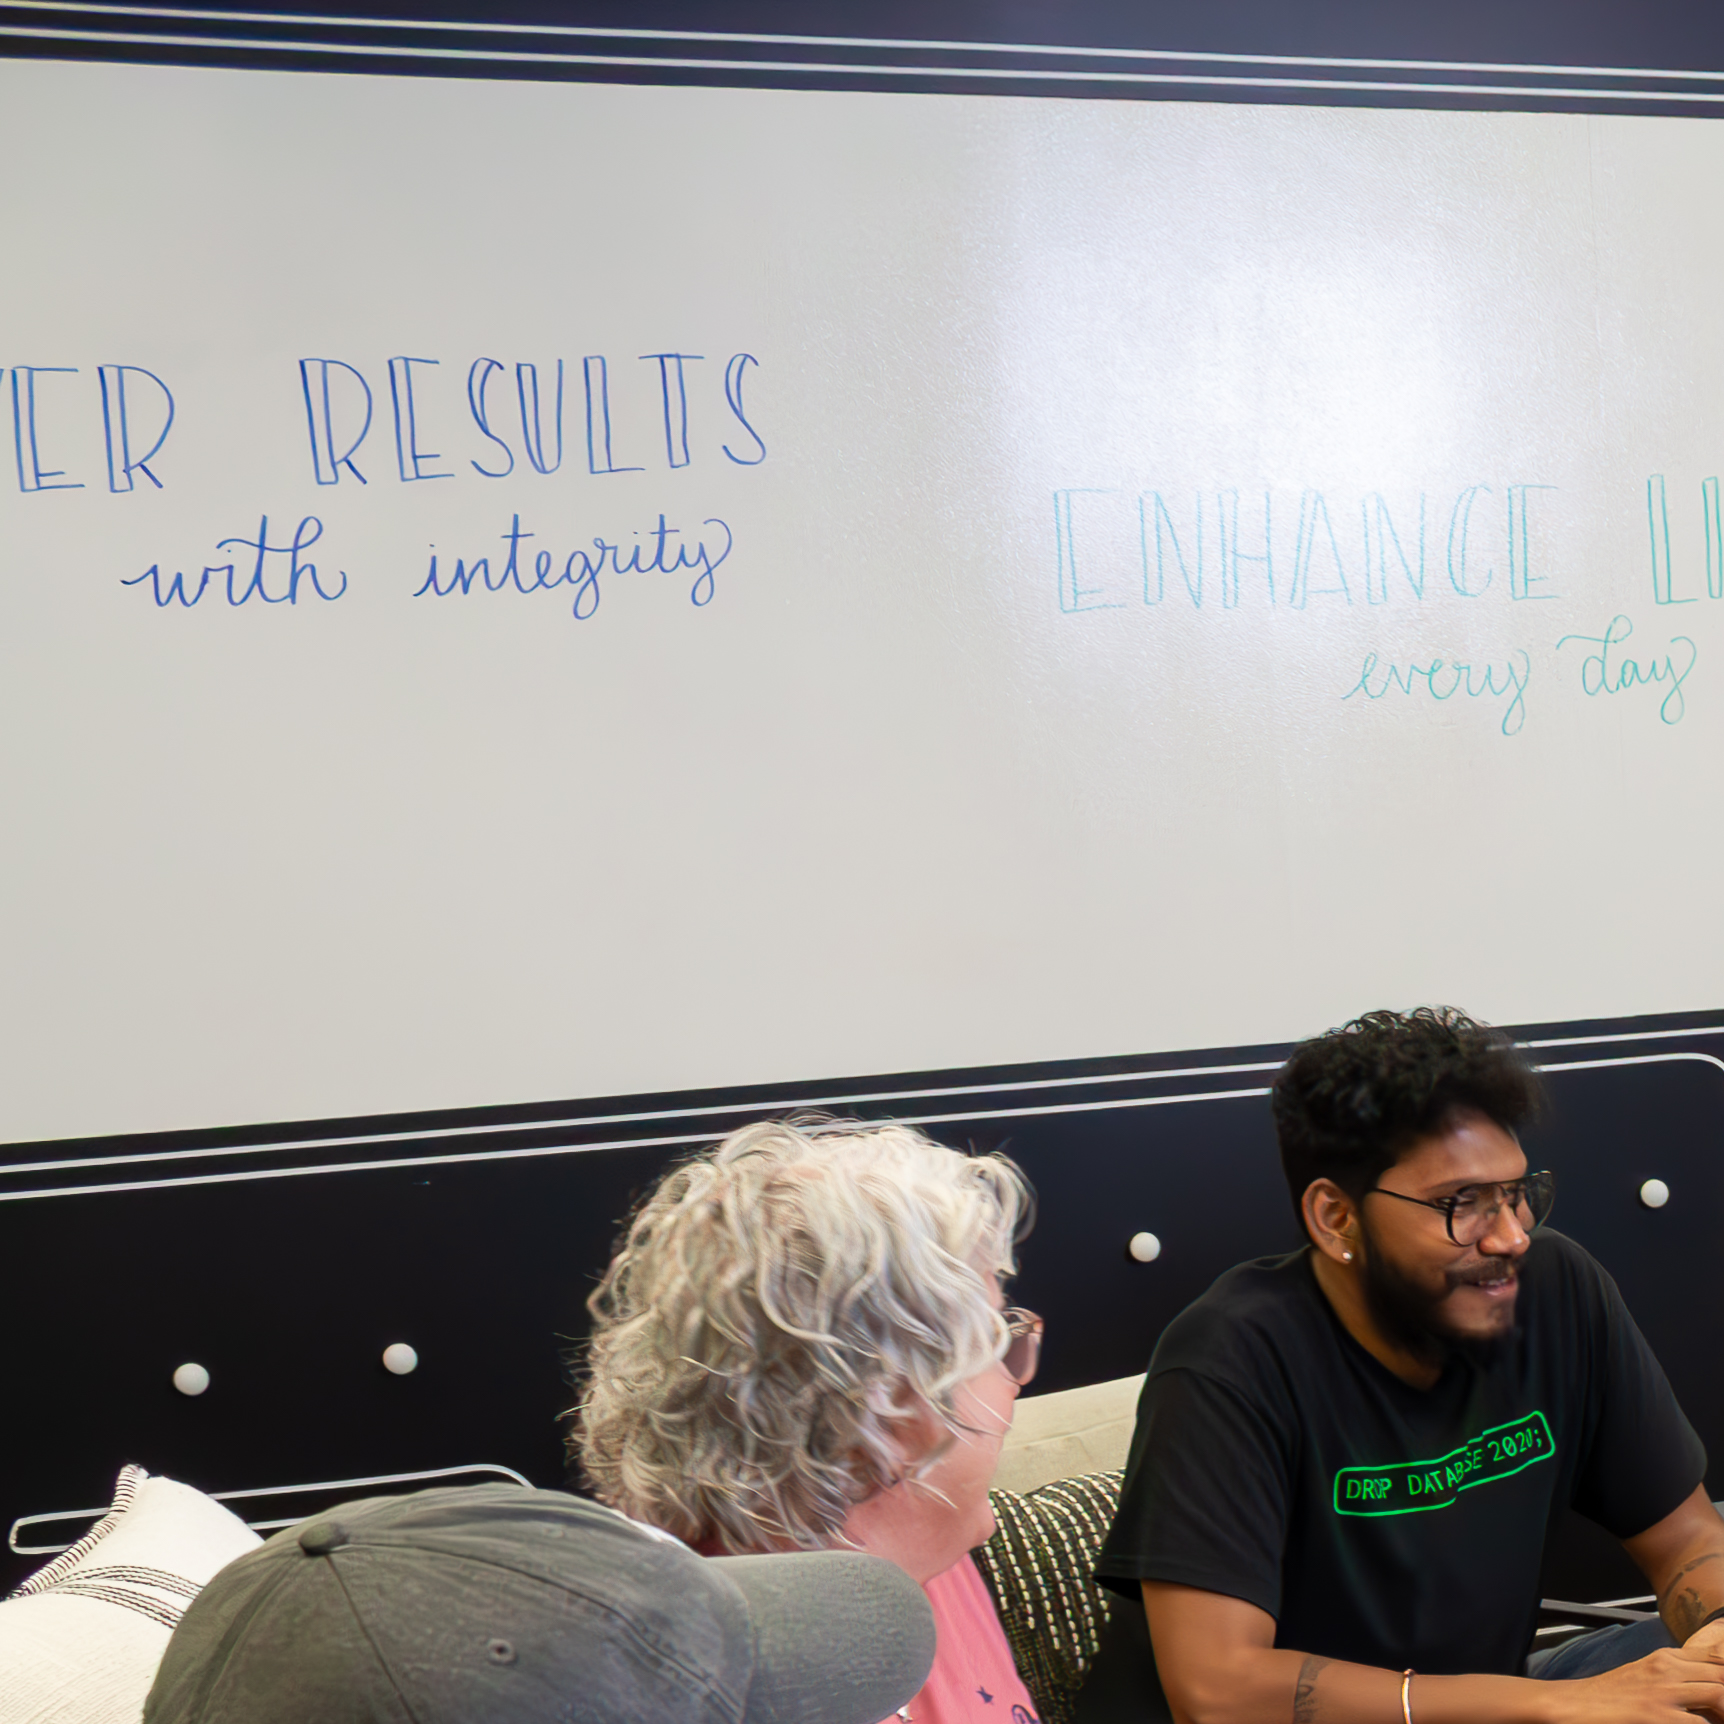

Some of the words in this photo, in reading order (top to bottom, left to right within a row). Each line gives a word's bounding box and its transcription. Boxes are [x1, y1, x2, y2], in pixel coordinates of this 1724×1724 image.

[0, 363, 174, 493] ER
[299, 352, 768, 485] RESULTS
[120, 515, 347, 608] with
[412, 512, 733, 620] integrity
[1052, 482, 1565, 614] ENHANCE
[1341, 647, 1532, 736] every
[1554, 614, 1698, 725] day
[1345, 1477, 1393, 1500] DROP
